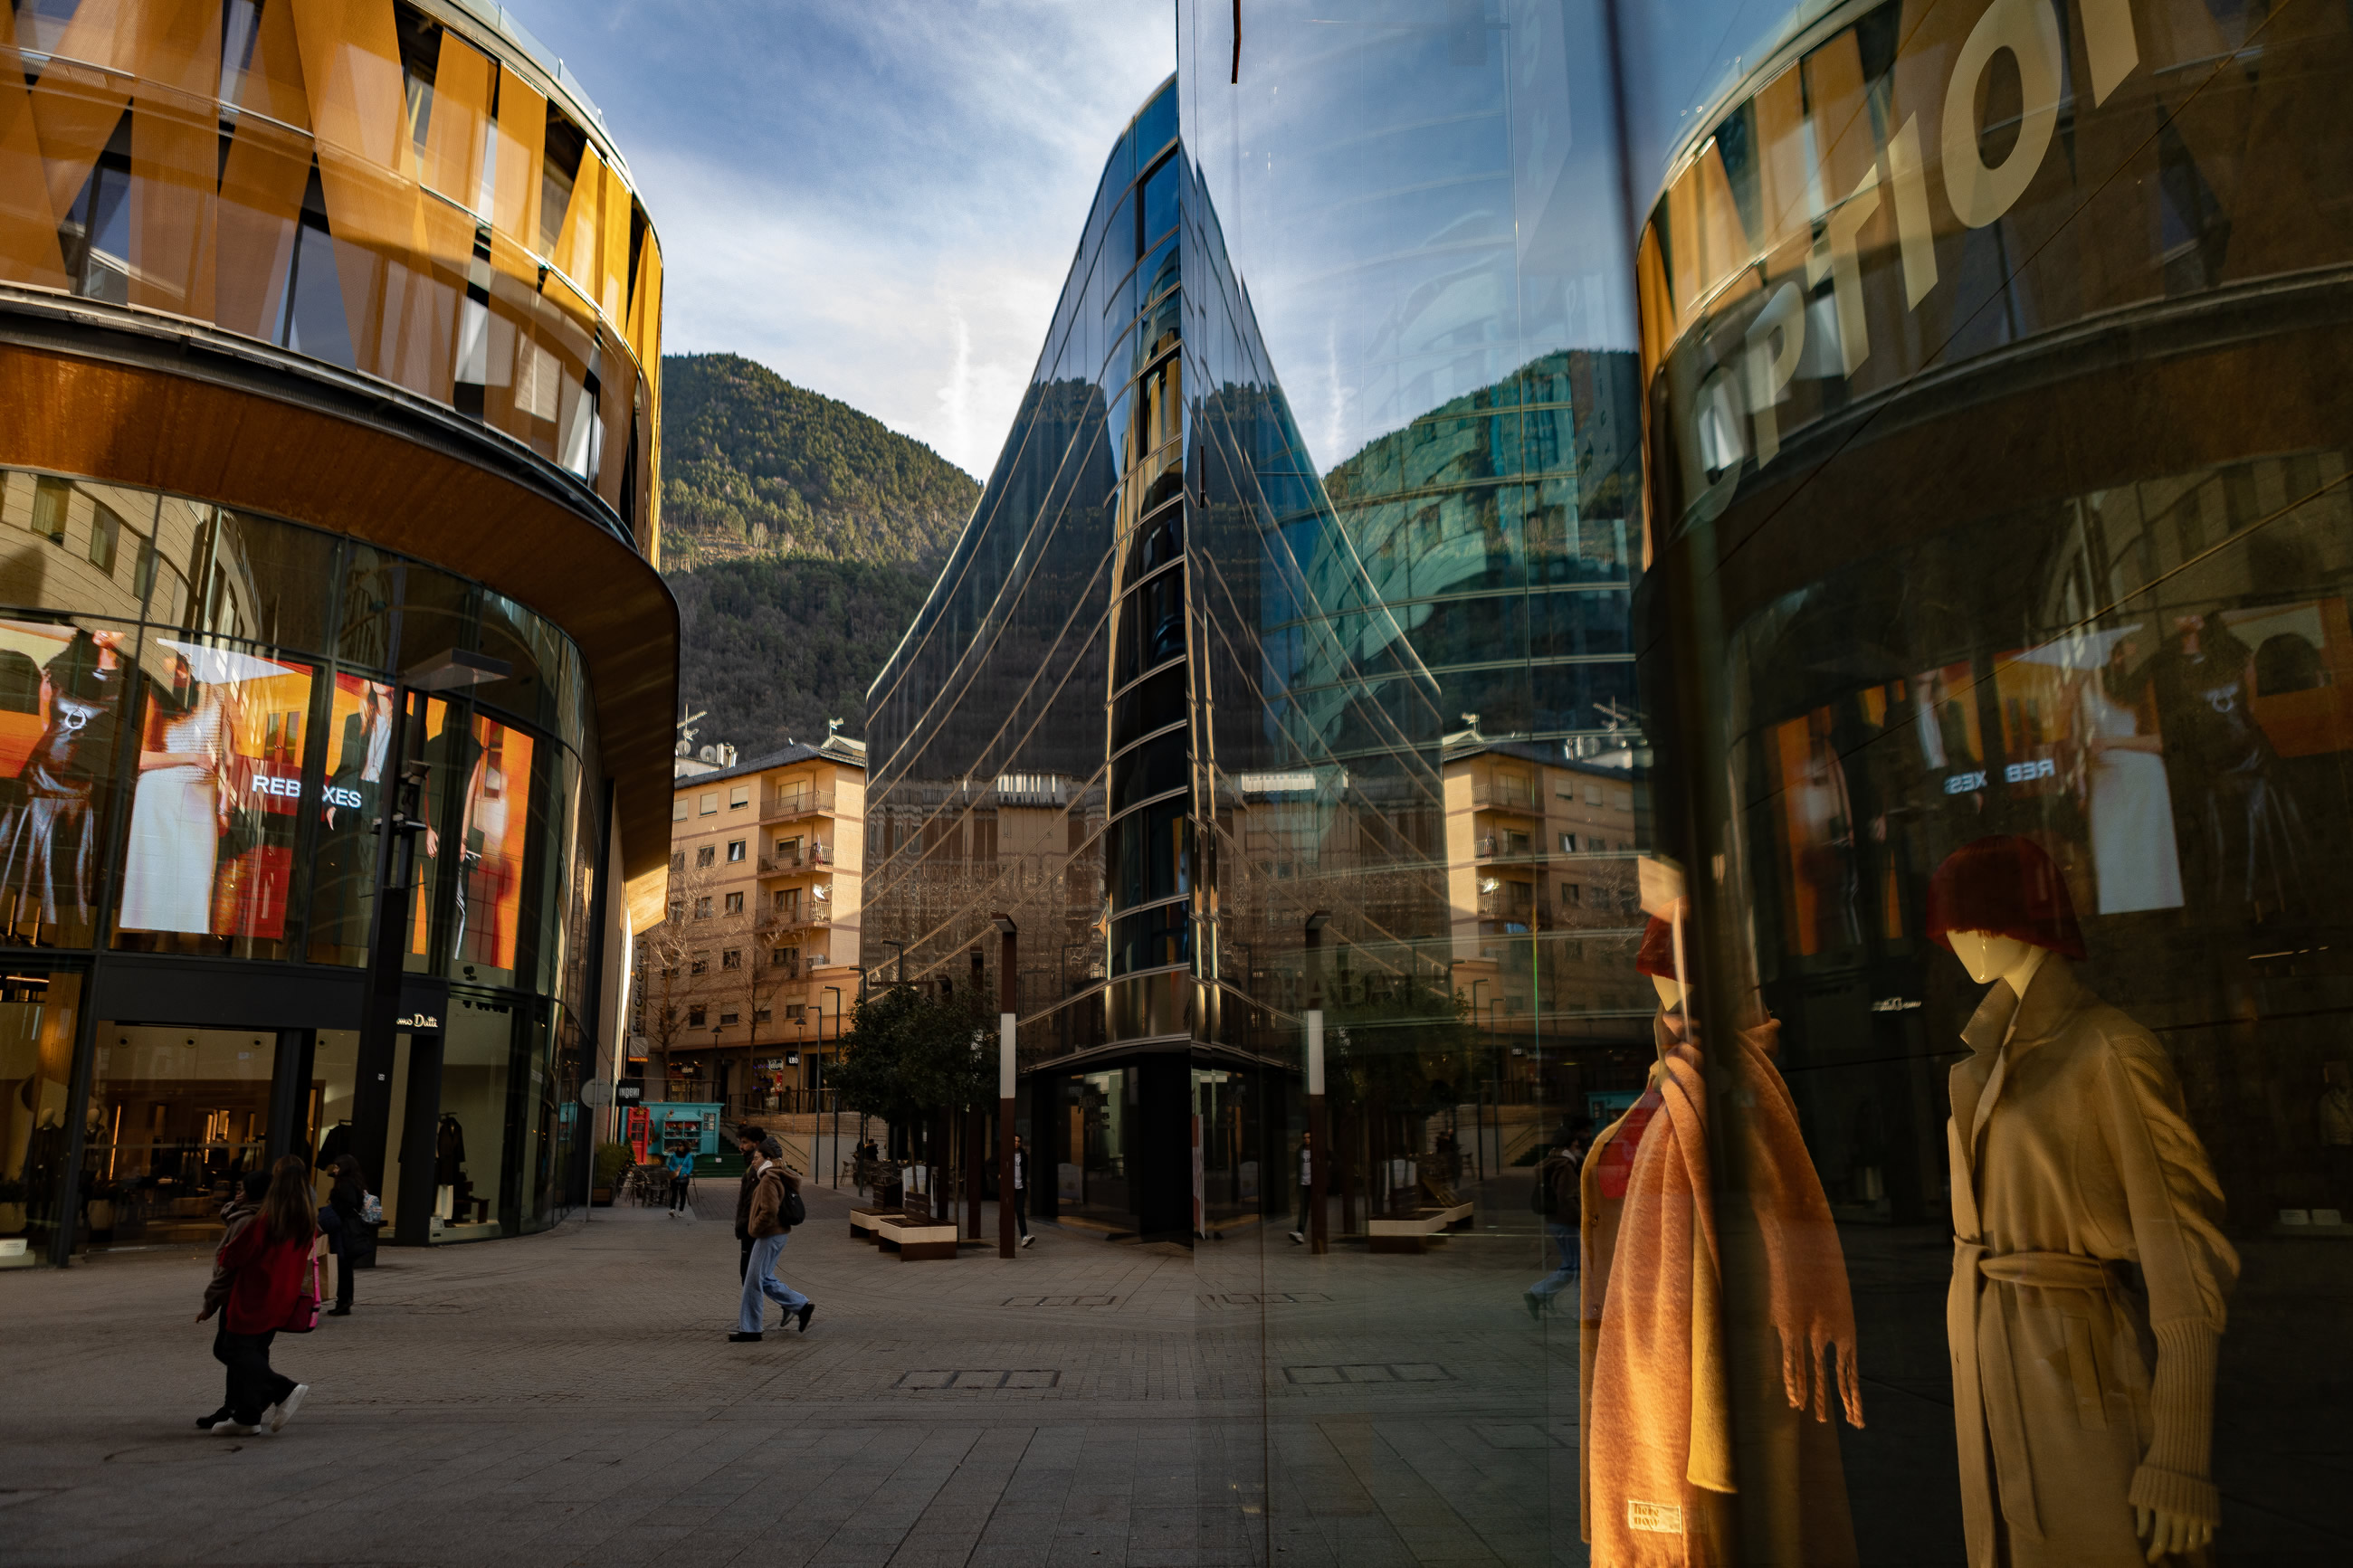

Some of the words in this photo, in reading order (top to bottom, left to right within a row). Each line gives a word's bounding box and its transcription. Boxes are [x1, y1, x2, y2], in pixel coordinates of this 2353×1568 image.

[252, 774, 362, 809] REBXES
[635, 955, 644, 982] Color
[414, 1012, 439, 1028] Dutti
[633, 1011, 642, 1032] Foto
[1634, 1503, 1660, 1517] here
[1634, 1516, 1660, 1529] now
